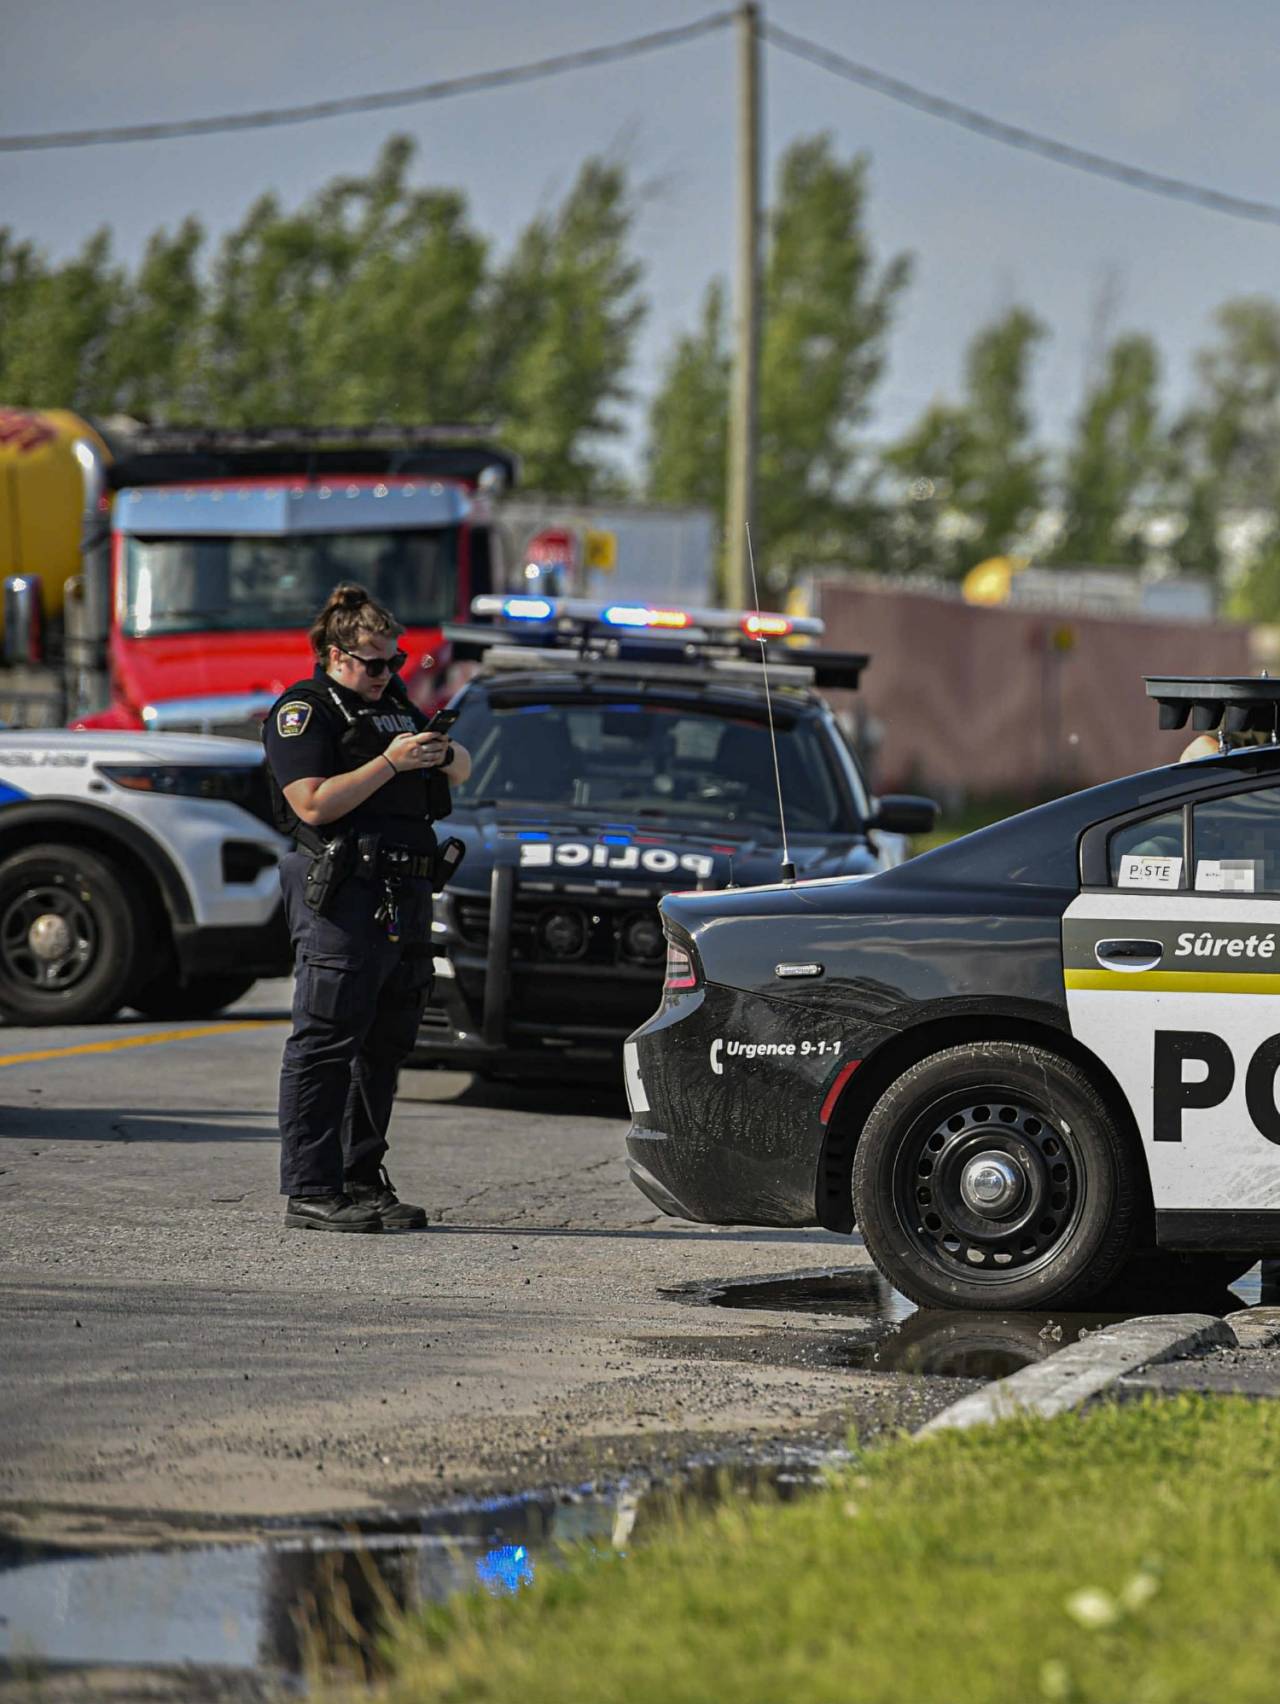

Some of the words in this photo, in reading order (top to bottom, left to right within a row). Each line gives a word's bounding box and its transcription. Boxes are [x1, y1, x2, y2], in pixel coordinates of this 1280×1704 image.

[1175, 932, 1275, 957] Sûreté
[726, 1041, 797, 1059] Urgence
[800, 1040, 842, 1056] 9-1-1
